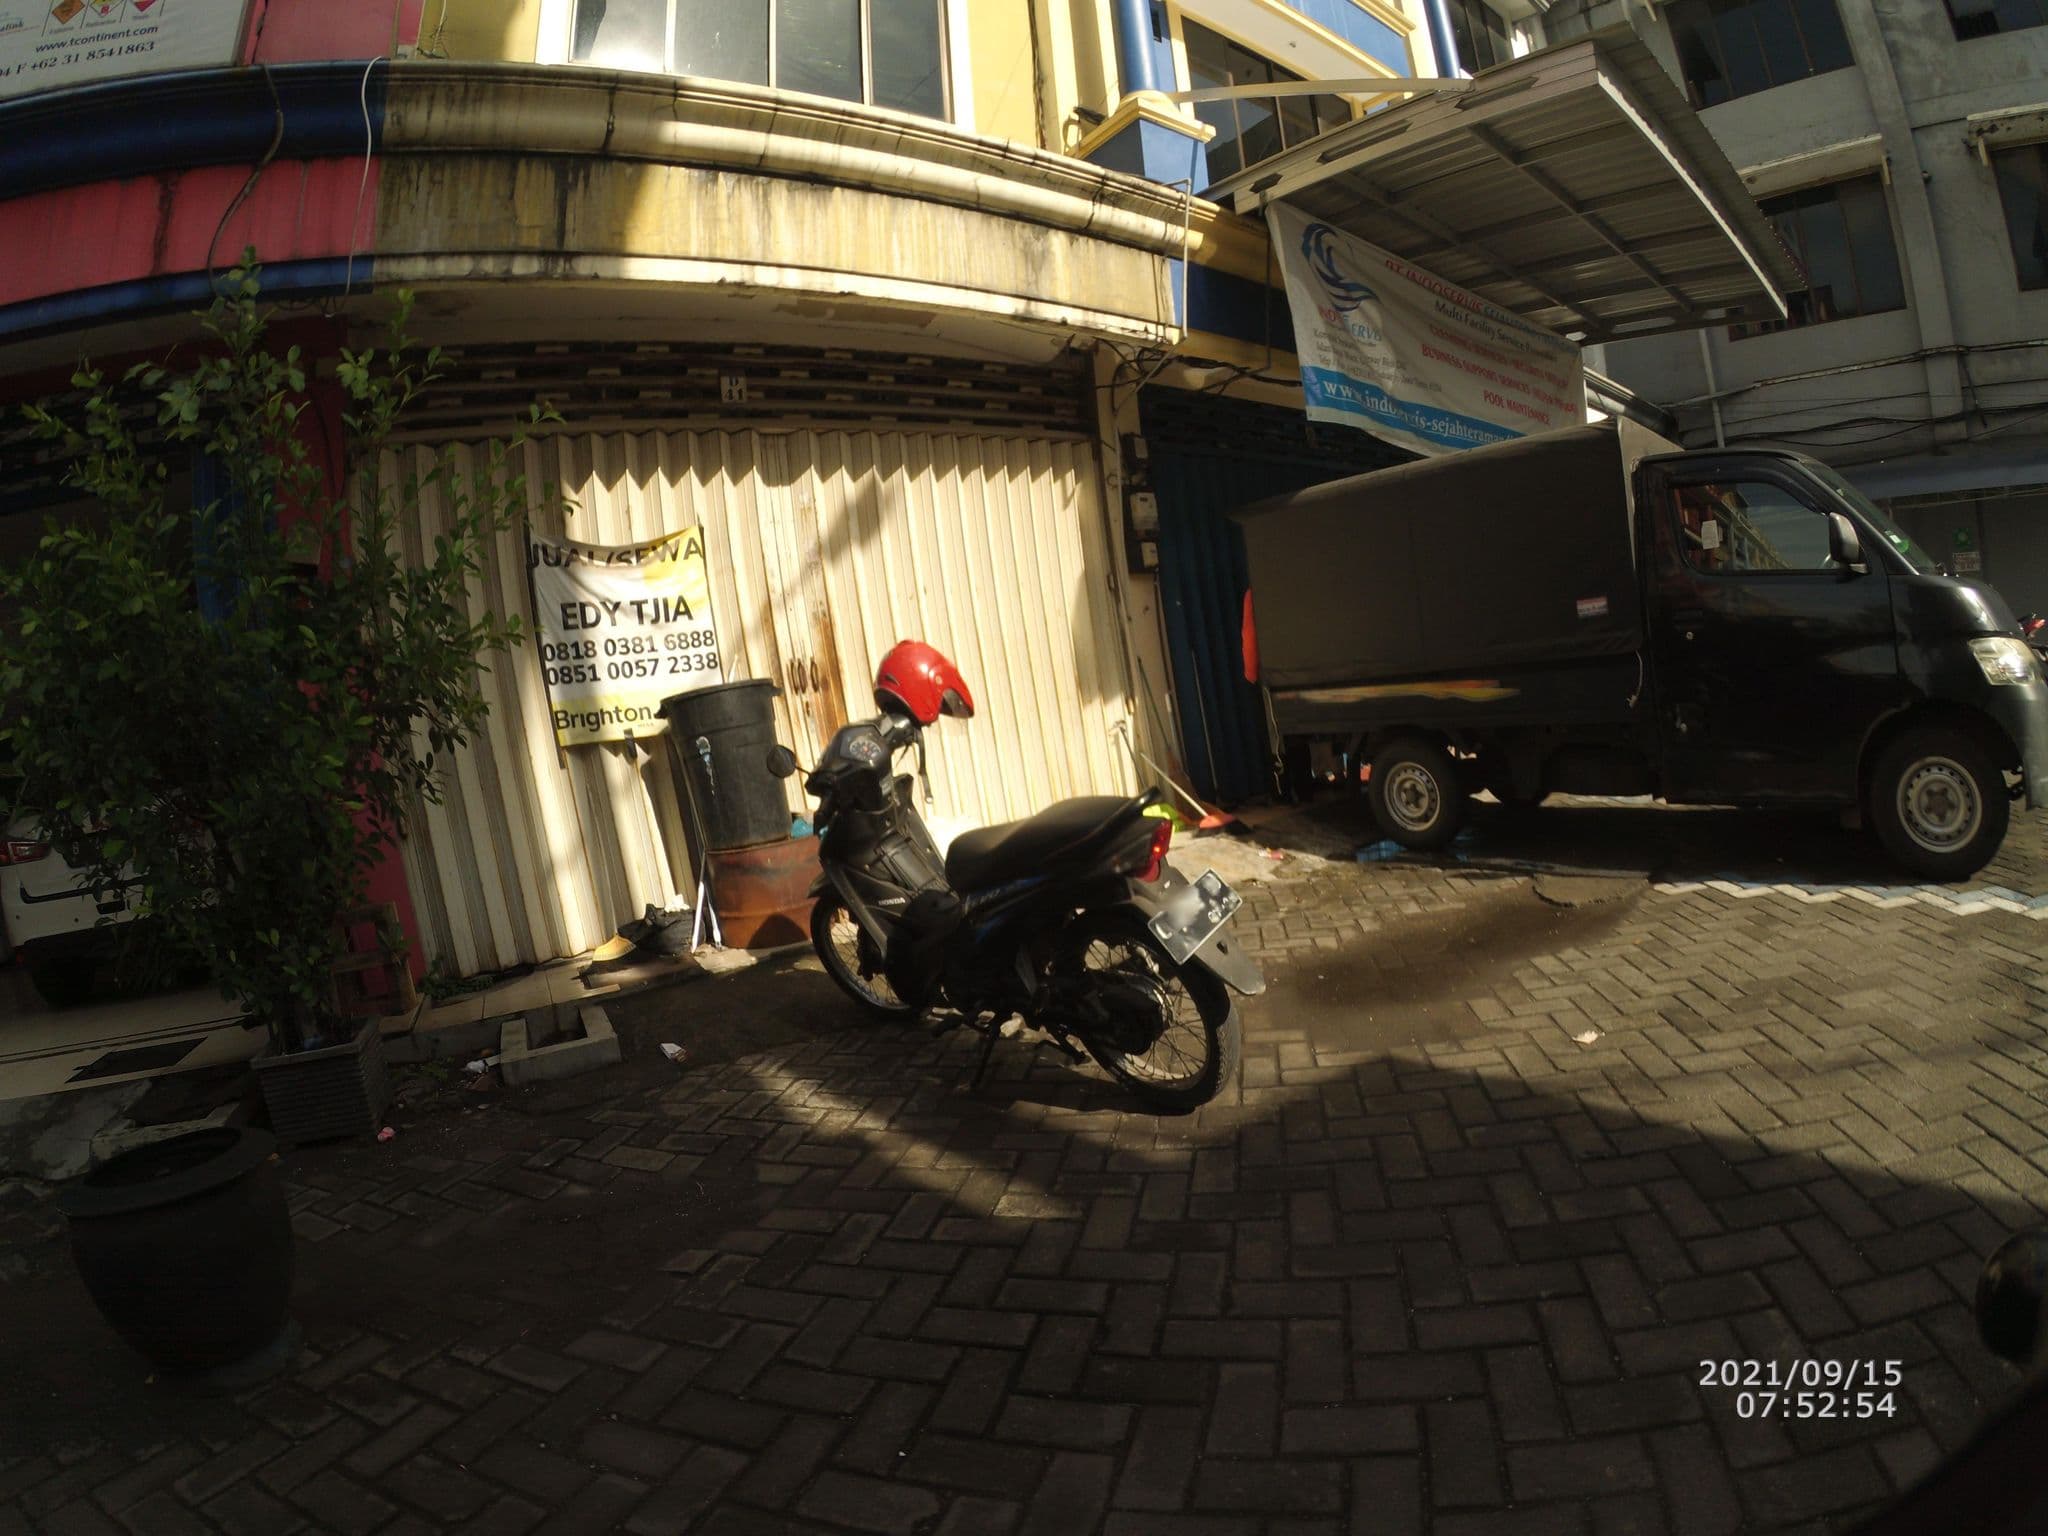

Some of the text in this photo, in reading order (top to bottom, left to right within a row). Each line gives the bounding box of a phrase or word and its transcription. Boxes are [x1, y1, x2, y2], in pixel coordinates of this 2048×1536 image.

[31, 57, 58, 71] +62
[61, 53, 80, 65] 31
[86, 40, 156, 61] 8541863
[36, 26, 159, 53] www.tcontinent.com
[560, 595, 694, 631] EDY TJIA
[543, 629, 715, 663] 0818 0381 6888
[546, 652, 719, 686] 0851 0057 2338
[554, 703, 652, 732] Brighton
